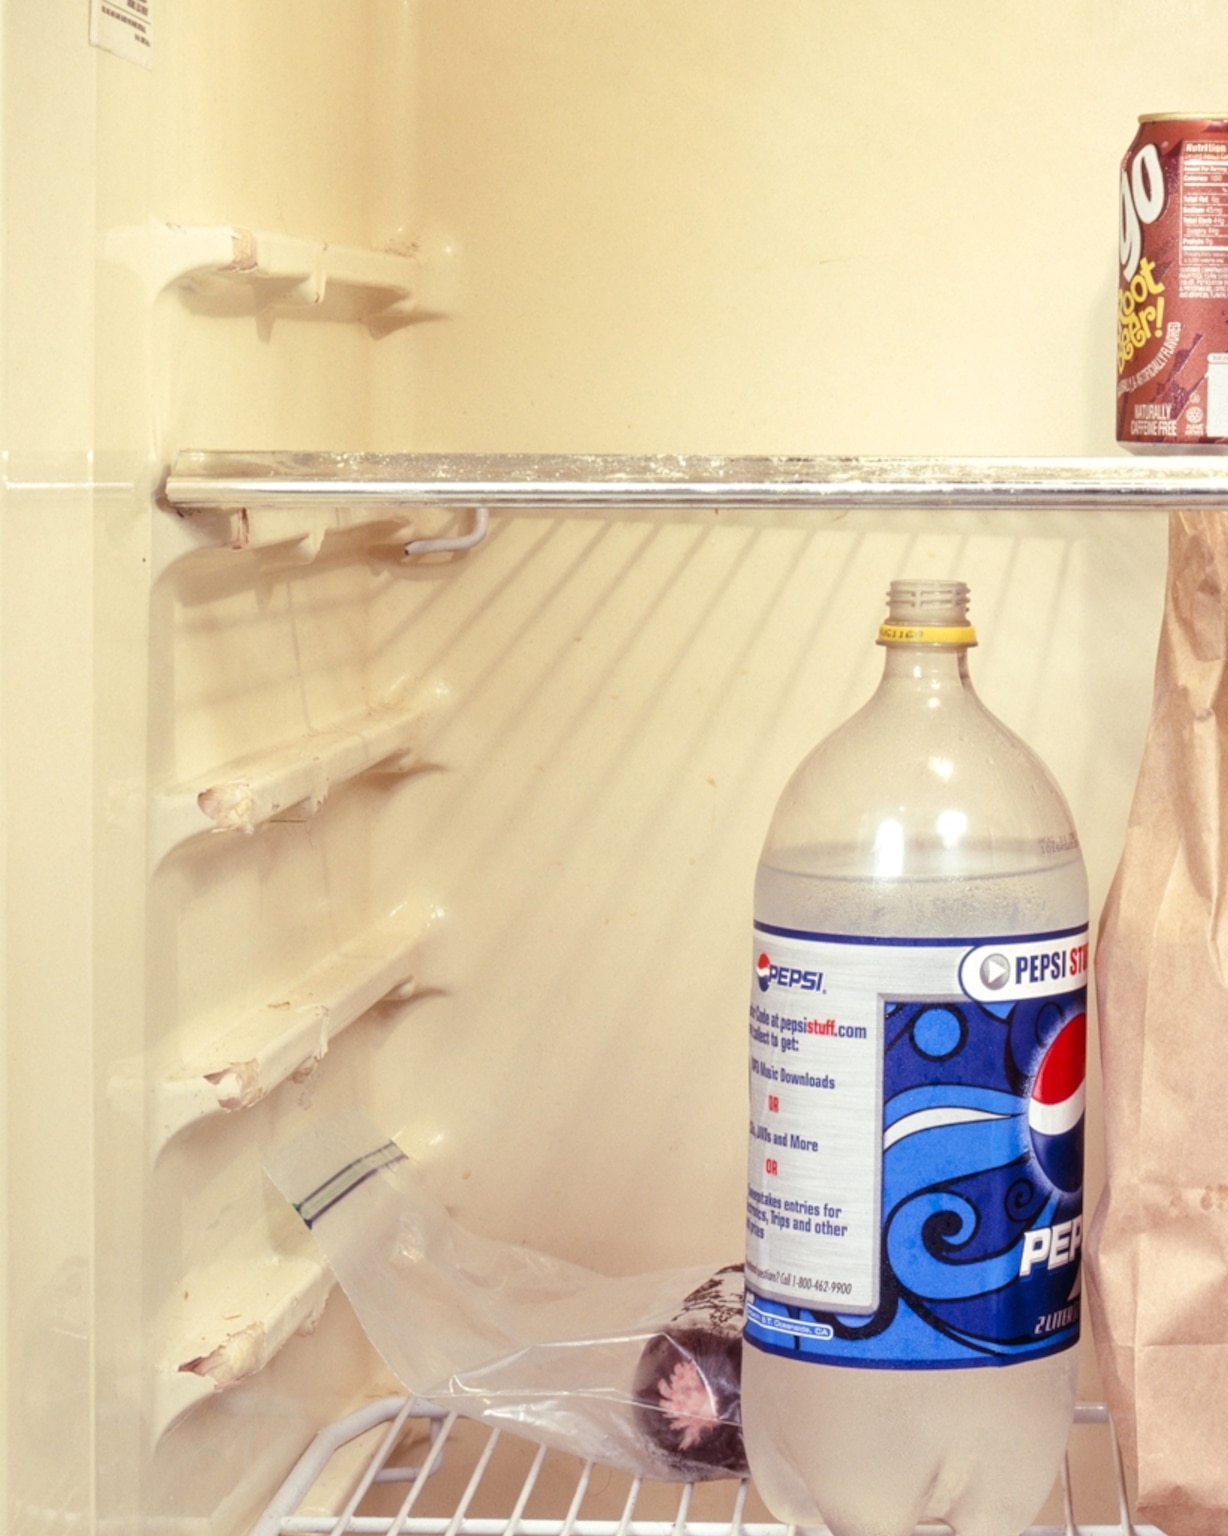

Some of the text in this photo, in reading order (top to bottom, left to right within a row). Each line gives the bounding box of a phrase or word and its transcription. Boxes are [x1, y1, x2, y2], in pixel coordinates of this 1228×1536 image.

[1185, 143, 1227, 153] Nutrition
[1118, 257, 1166, 323] oot
[1117, 296, 1165, 376] eer!
[768, 963, 824, 993] PEPSI
[1015, 950, 1067, 985] PEPSI
[780, 1016, 868, 1039] pepsistuff.com
[781, 1036, 800, 1053] get:
[779, 1067, 836, 1090] Downloads
[772, 1132, 788, 1147] and
[790, 1133, 819, 1153] More
[765, 1157, 779, 1177] OR
[784, 1200, 821, 1217] entries
[823, 1202, 843, 1219] for
[792, 1217, 812, 1233] and
[814, 1219, 849, 1238] other
[791, 1274, 854, 1296] 1-800-462-9900
[814, 1326, 829, 1337] CA
[1034, 1315, 1047, 1335] 2
